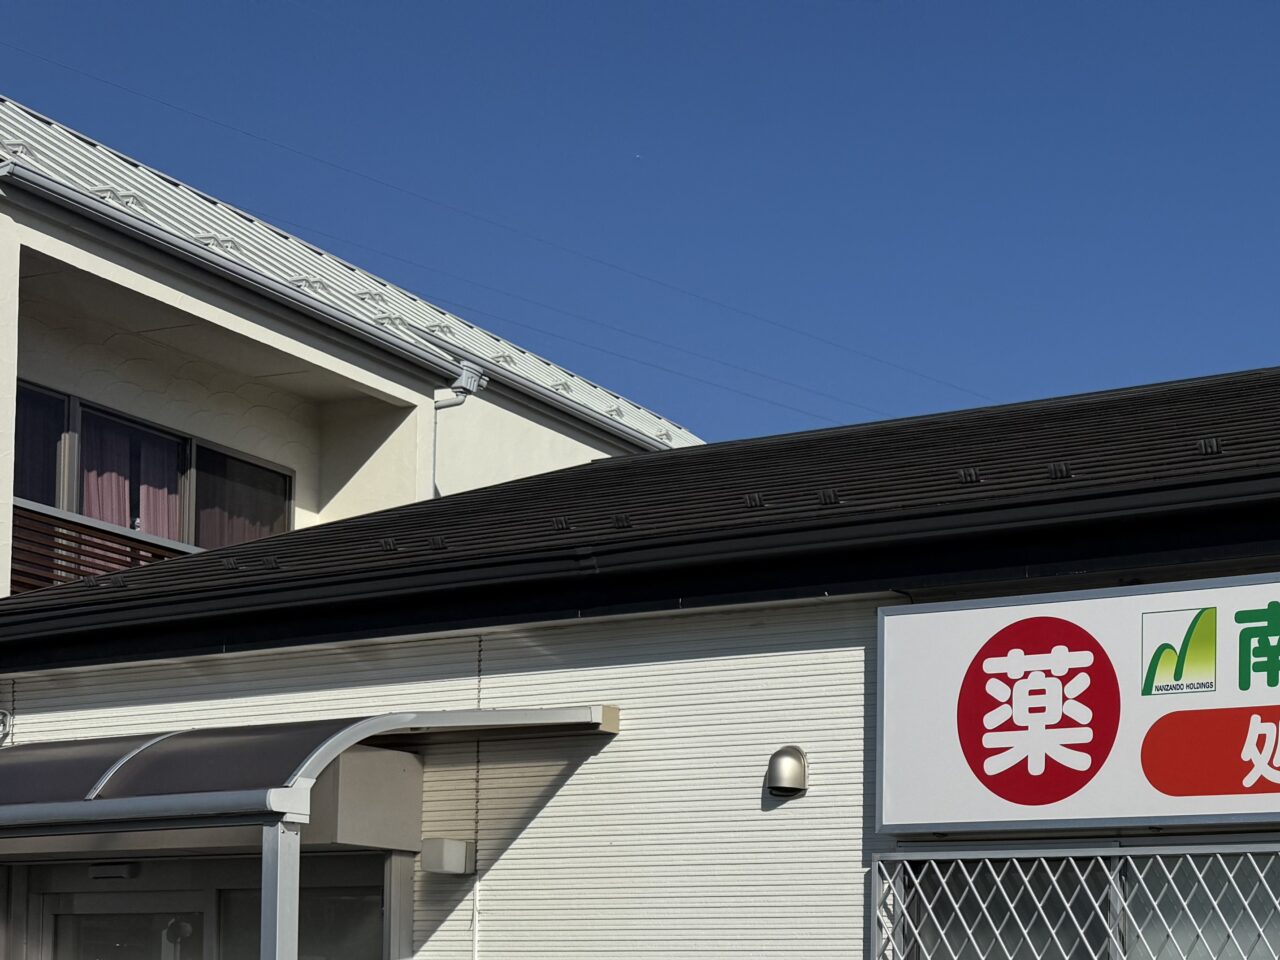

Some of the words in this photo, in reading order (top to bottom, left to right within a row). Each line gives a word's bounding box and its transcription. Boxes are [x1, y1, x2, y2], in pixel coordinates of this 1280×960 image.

[982, 646, 1093, 776] 薬
[1154, 683, 1185, 692] NANZANDO
[1186, 681, 1214, 690] HOLDINGS
